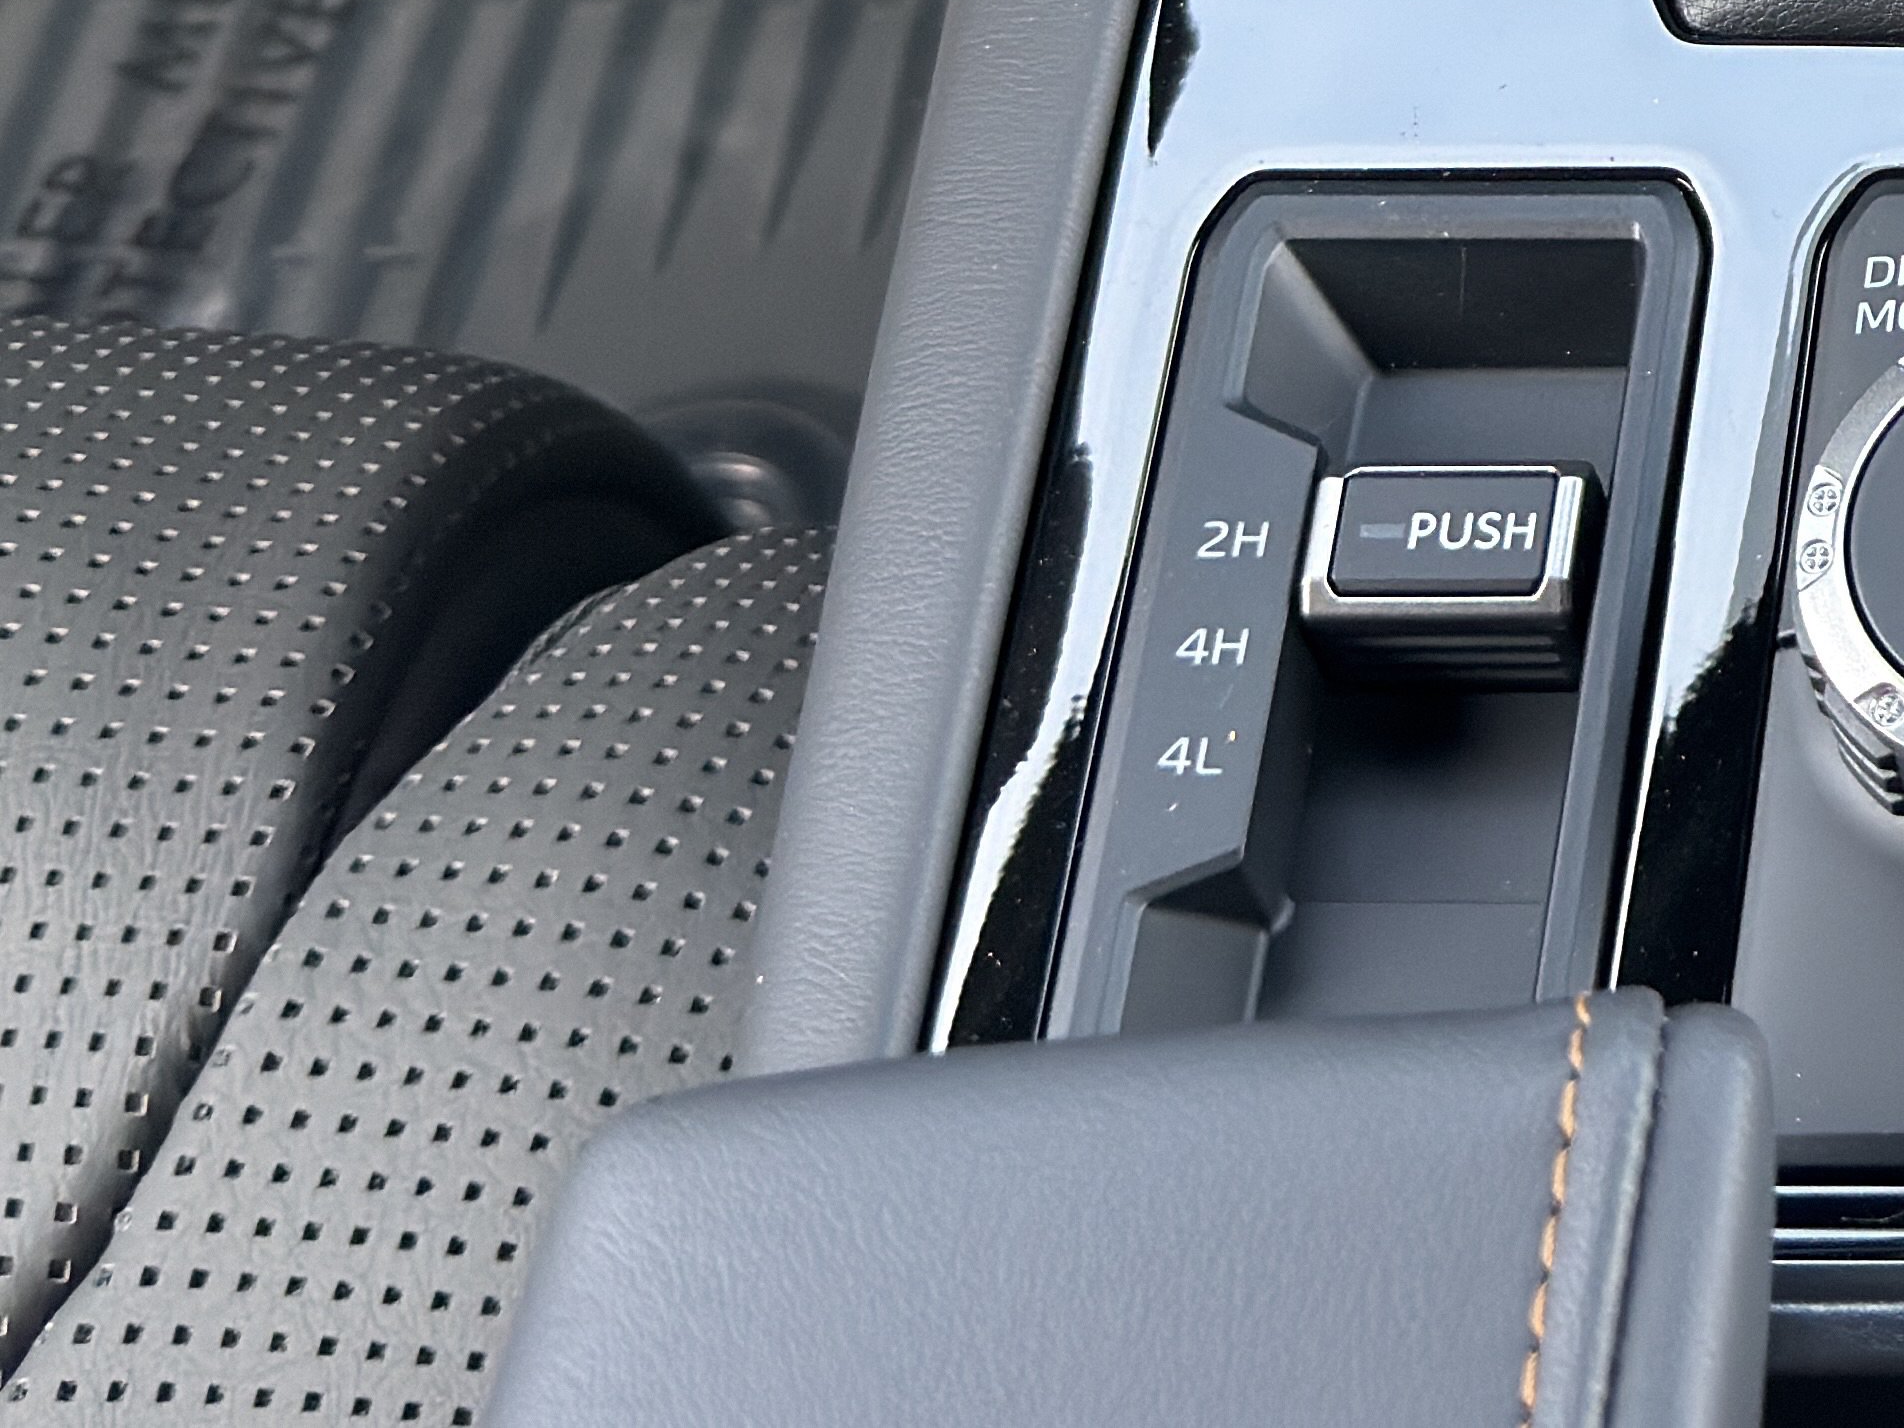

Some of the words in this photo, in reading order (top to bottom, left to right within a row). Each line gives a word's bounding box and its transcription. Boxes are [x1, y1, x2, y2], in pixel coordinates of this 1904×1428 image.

[1196, 520, 1270, 559] 2H
[1406, 511, 1537, 551] PUSH
[1175, 627, 1250, 666] 4H
[1156, 736, 1223, 776] 4L
